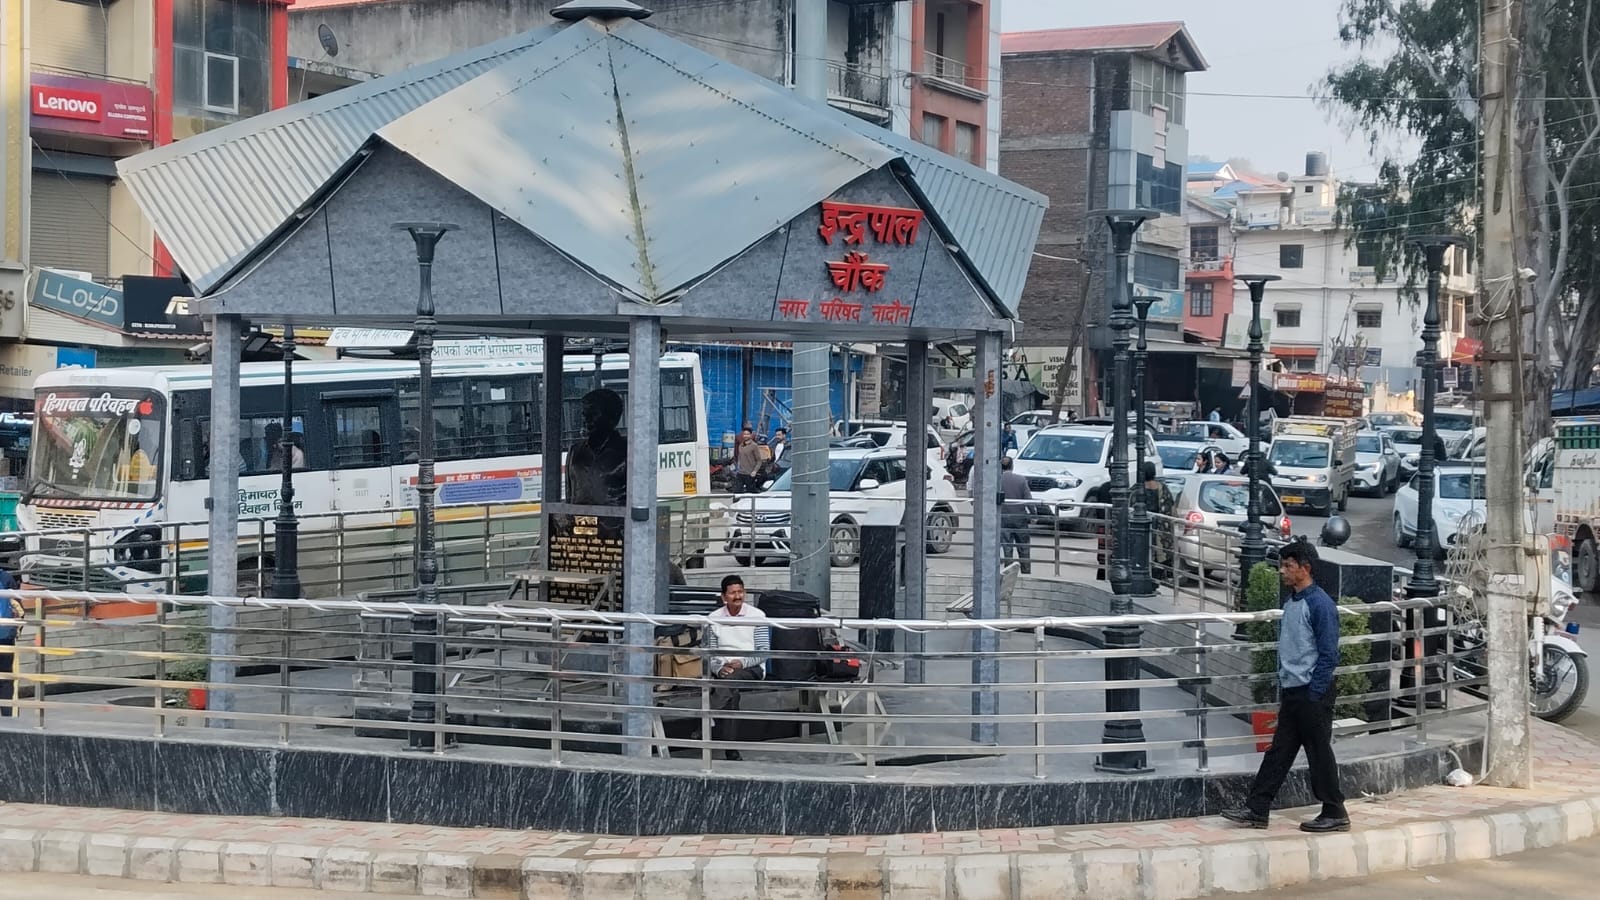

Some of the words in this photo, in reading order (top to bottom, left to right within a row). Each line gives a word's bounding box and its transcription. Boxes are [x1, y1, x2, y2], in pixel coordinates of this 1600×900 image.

[38, 91, 98, 114] Lenovo
[42, 278, 119, 316] LLOYD
[778, 299, 810, 319] नगर
[819, 297, 864, 322] परिषद
[870, 299, 912, 323] नादौन
[0, 363, 33, 377] Retailer
[42, 392, 90, 415] हिमाचल
[88, 392, 140, 416] परिवहन
[659, 450, 692, 469] HRTC
